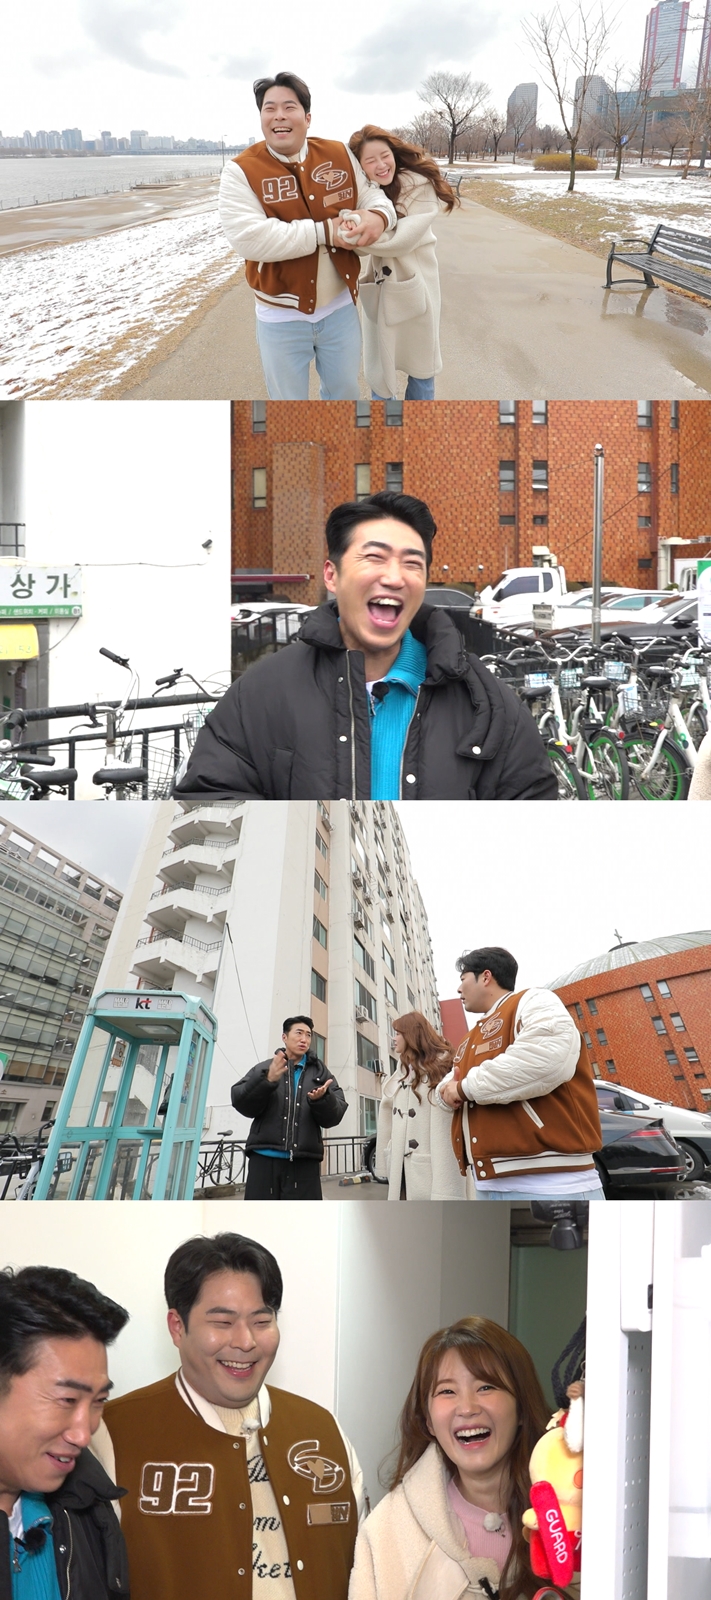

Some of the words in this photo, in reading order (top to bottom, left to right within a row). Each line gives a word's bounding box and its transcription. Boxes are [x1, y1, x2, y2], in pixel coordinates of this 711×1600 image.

[261, 175, 298, 204] 92
[135, 997, 152, 1010] kt
[139, 1461, 215, 1515] 92
[545, 1509, 568, 1564] GUARD
